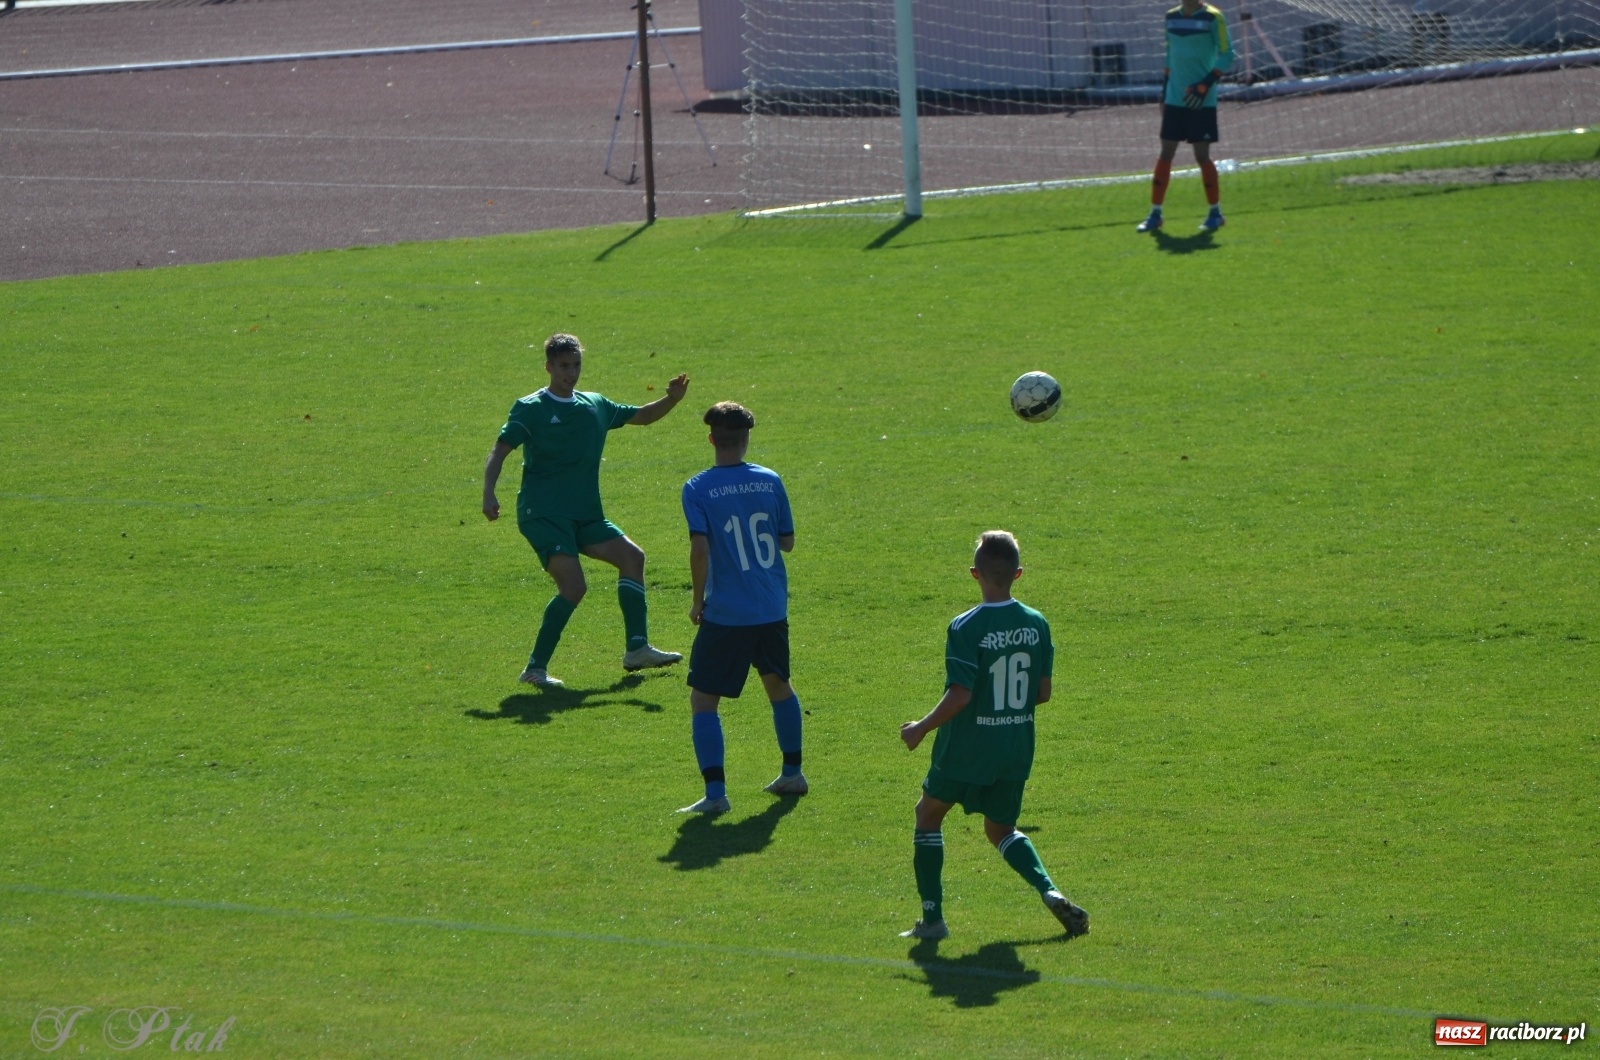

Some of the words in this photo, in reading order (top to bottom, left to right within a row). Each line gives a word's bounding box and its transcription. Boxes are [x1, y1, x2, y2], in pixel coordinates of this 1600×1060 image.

[708, 488, 719, 498] KS
[719, 485, 739, 496] UNIA
[723, 512, 776, 572] 16
[984, 627, 1040, 650] REKORD
[989, 652, 1031, 711] 16
